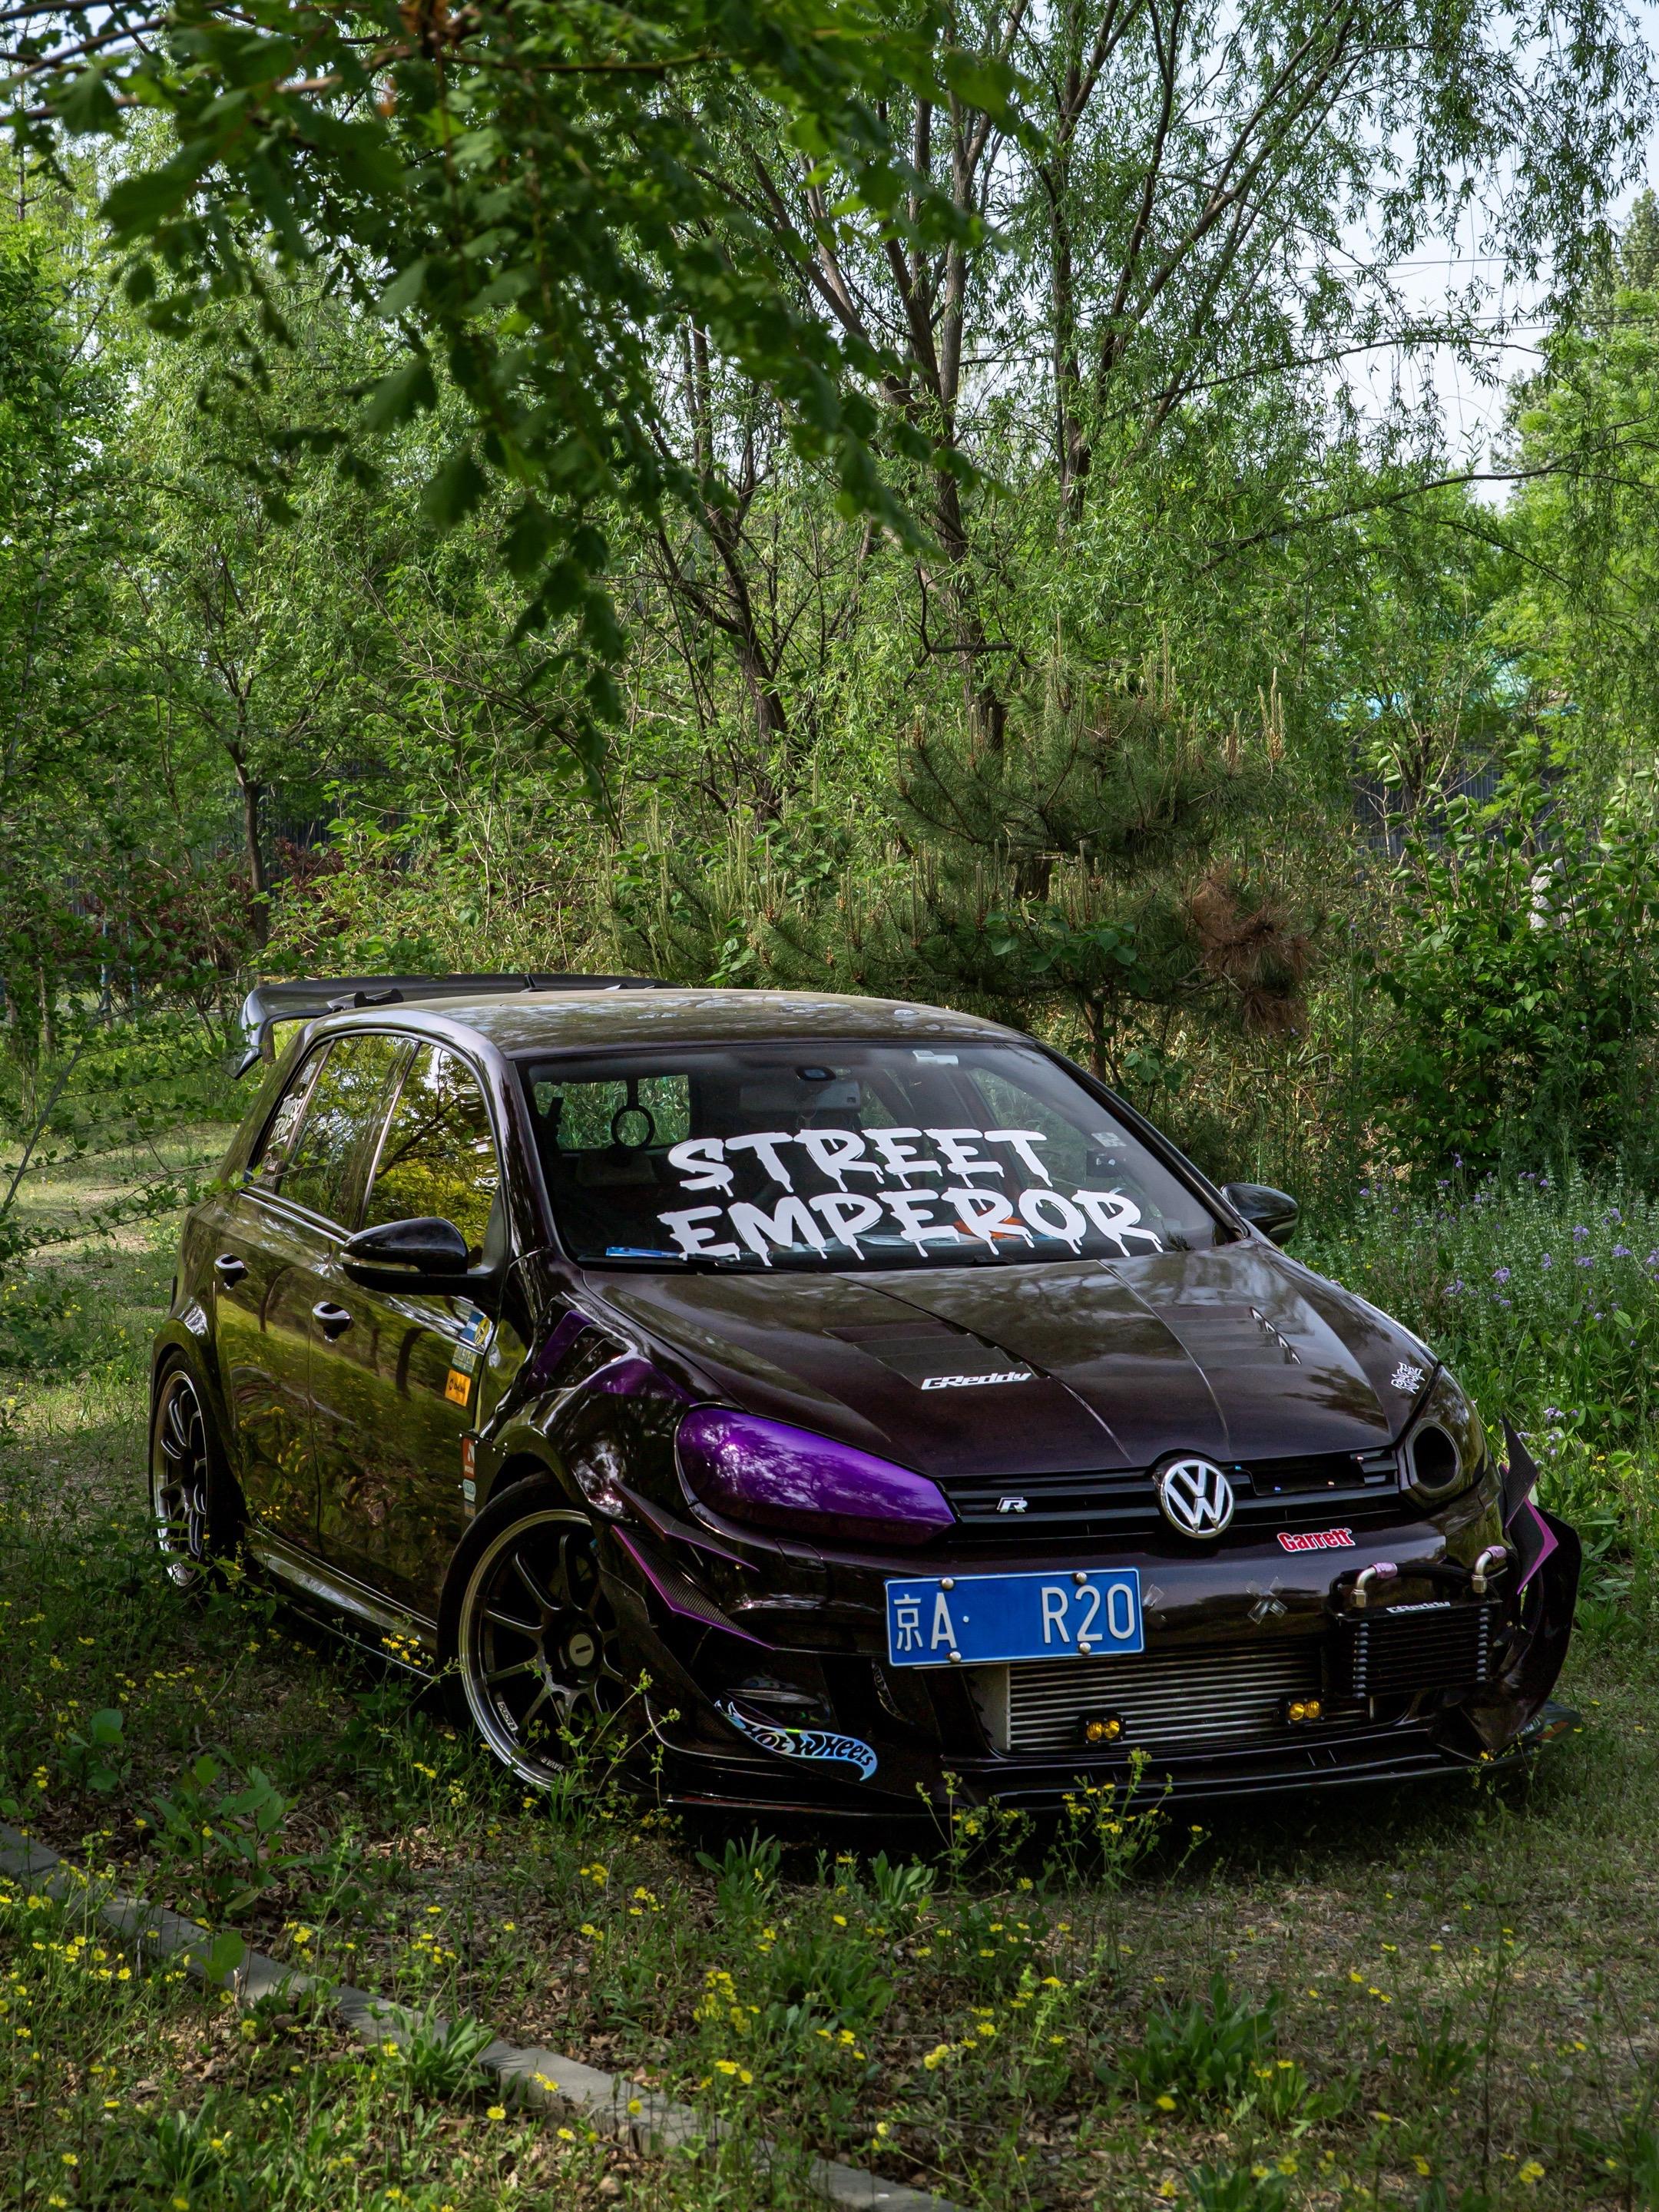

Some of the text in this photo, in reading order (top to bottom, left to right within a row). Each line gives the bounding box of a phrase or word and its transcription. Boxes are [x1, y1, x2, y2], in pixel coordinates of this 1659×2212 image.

[668, 1128, 1053, 1197] STREET
[657, 1187, 1163, 1267] EMPEROR
[921, 1372, 1031, 1390] GReddy
[997, 1497, 1028, 1513] R
[1277, 1528, 1356, 1552] Garrett
[1041, 1583, 1136, 1644] R20
